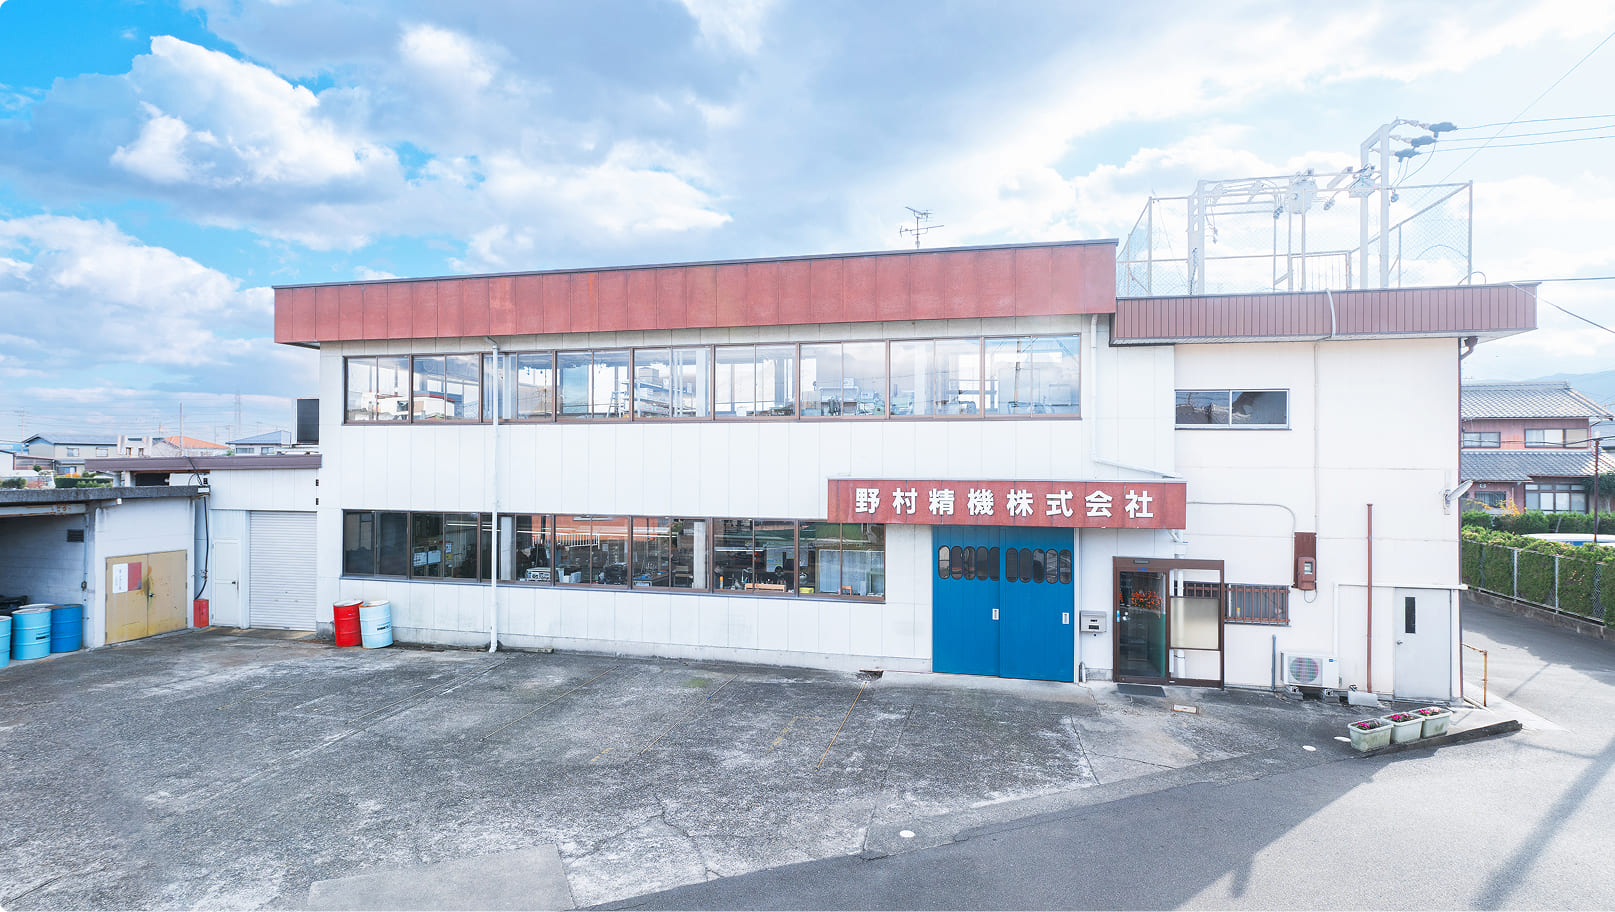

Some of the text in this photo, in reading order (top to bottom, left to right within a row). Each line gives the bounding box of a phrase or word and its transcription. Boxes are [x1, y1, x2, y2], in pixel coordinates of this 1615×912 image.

[855, 487, 1153, 518] 野村精機株式会社
